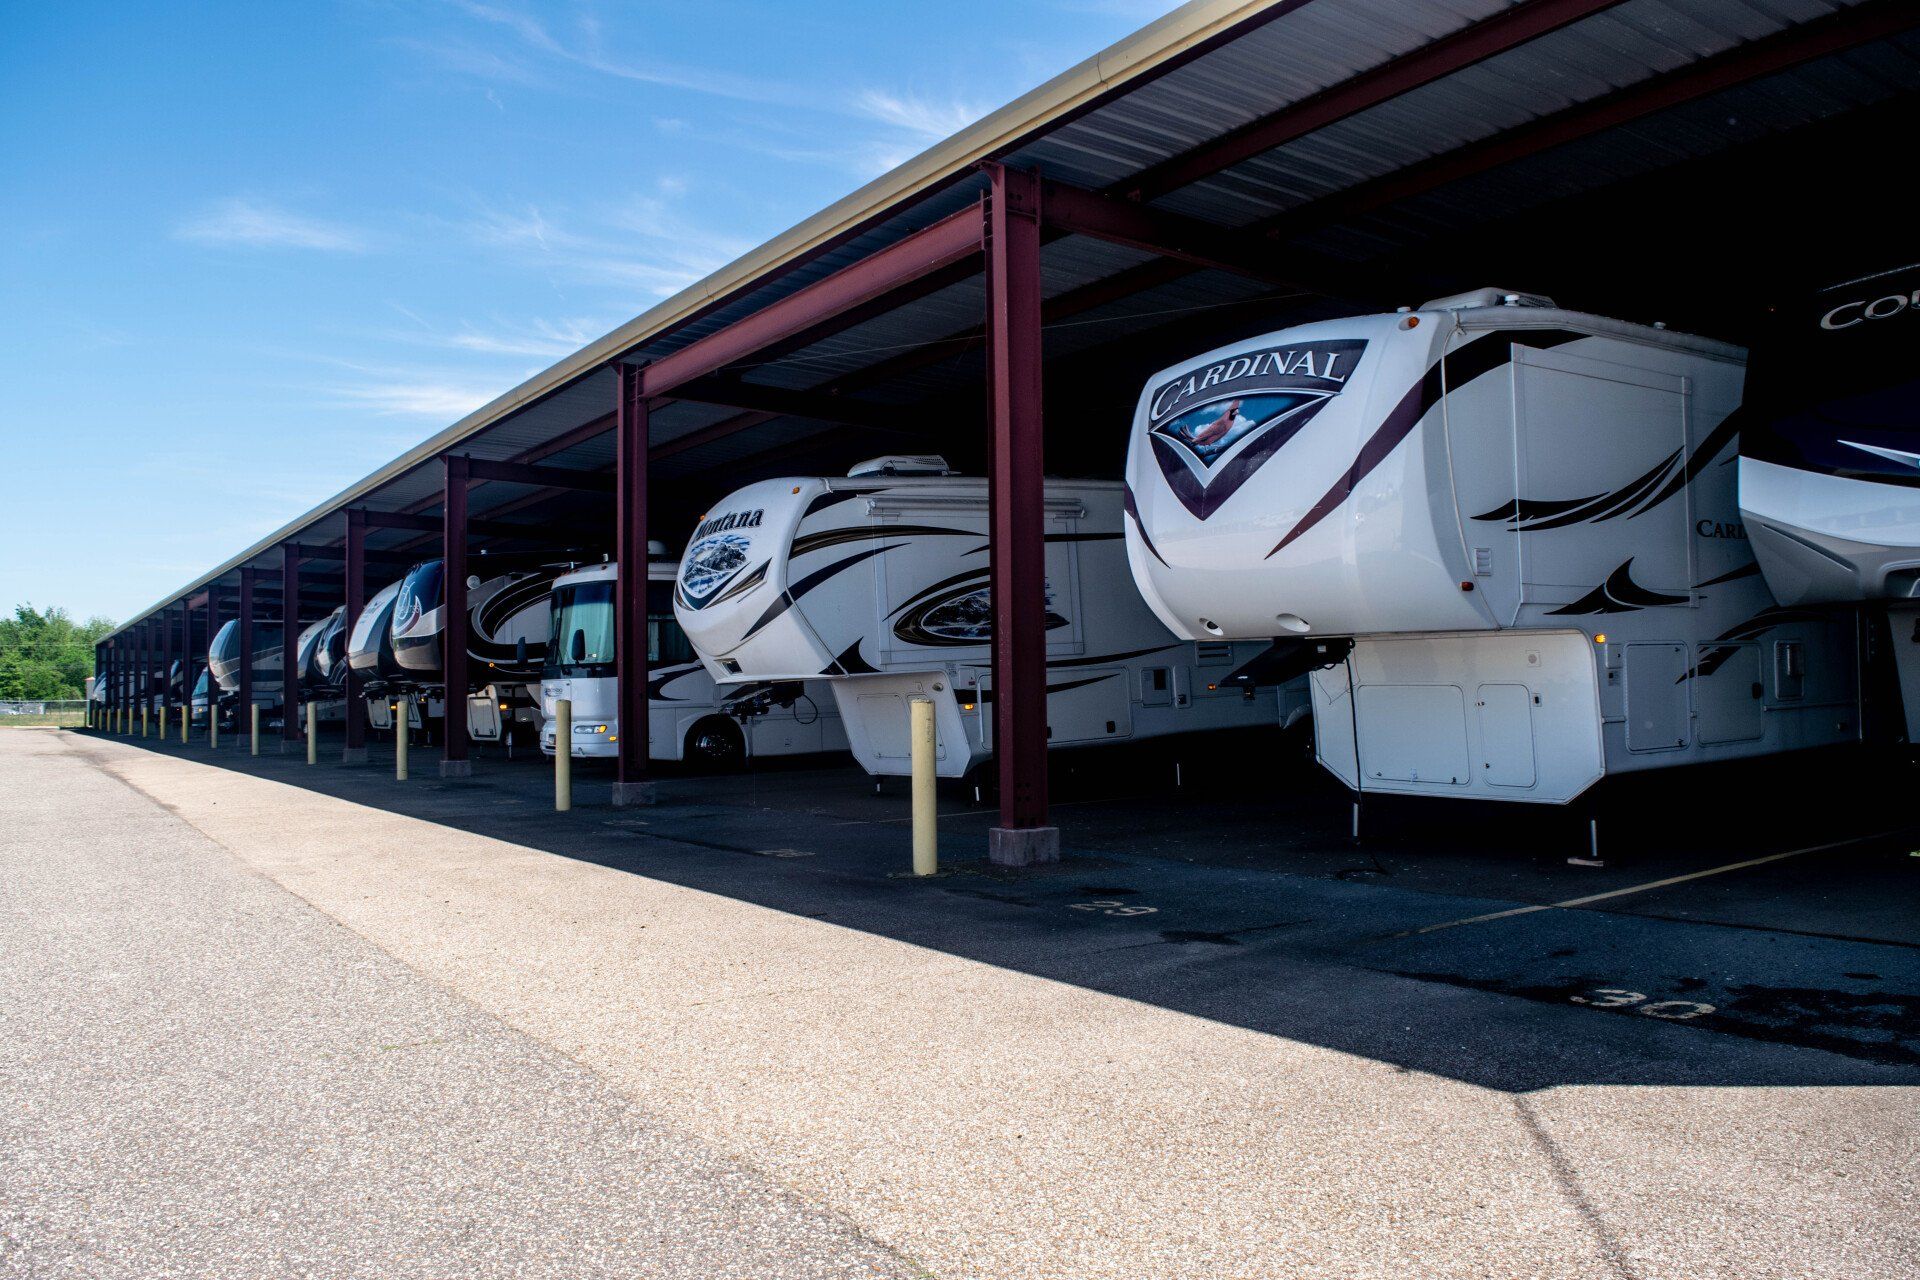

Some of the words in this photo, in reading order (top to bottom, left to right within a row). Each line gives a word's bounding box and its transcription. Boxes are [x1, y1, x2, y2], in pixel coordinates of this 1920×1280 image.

[1820, 290, 1920, 330] CO
[1150, 350, 1346, 421] CARDINAL
[695, 508, 764, 540] Montana
[1570, 988, 1716, 1019] 30
